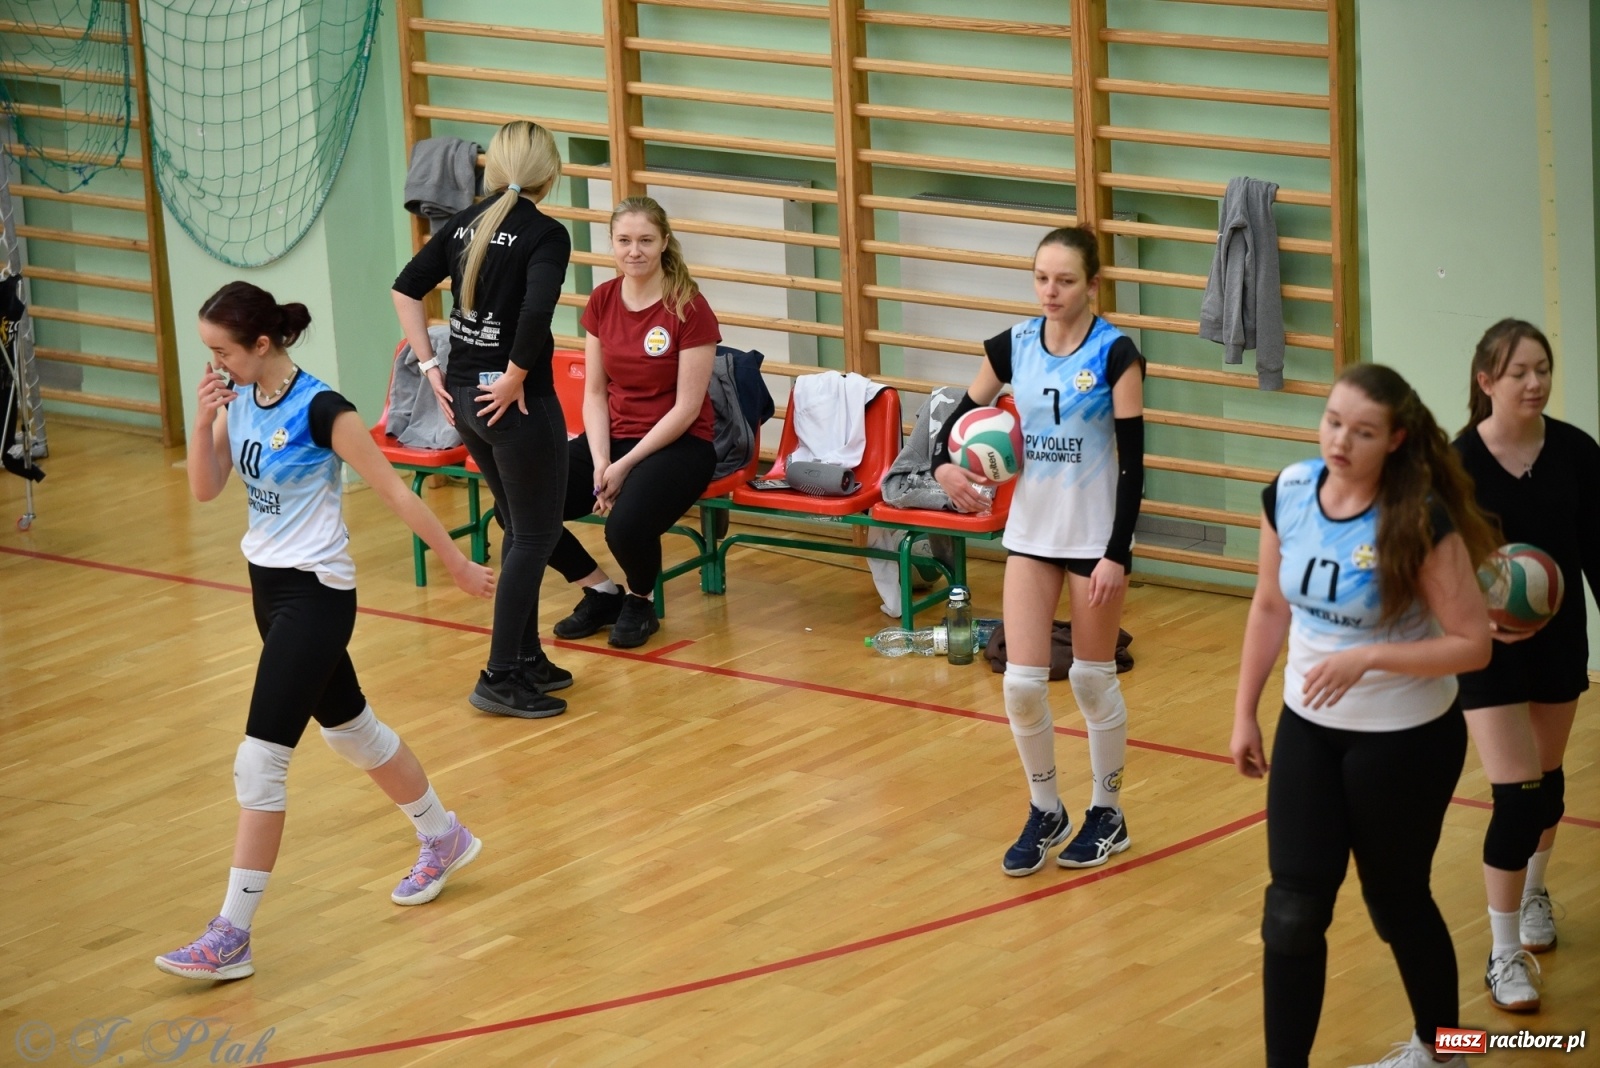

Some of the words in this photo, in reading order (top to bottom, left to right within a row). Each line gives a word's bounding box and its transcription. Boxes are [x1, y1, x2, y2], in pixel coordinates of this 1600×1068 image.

[1043, 387, 1061, 426] 7
[240, 438, 262, 480] 10
[1025, 434, 1040, 449] PV
[1041, 436, 1084, 452] VOLLEY
[1026, 449, 1082, 463] KRAPKOWICE
[1300, 556, 1341, 604] 17
